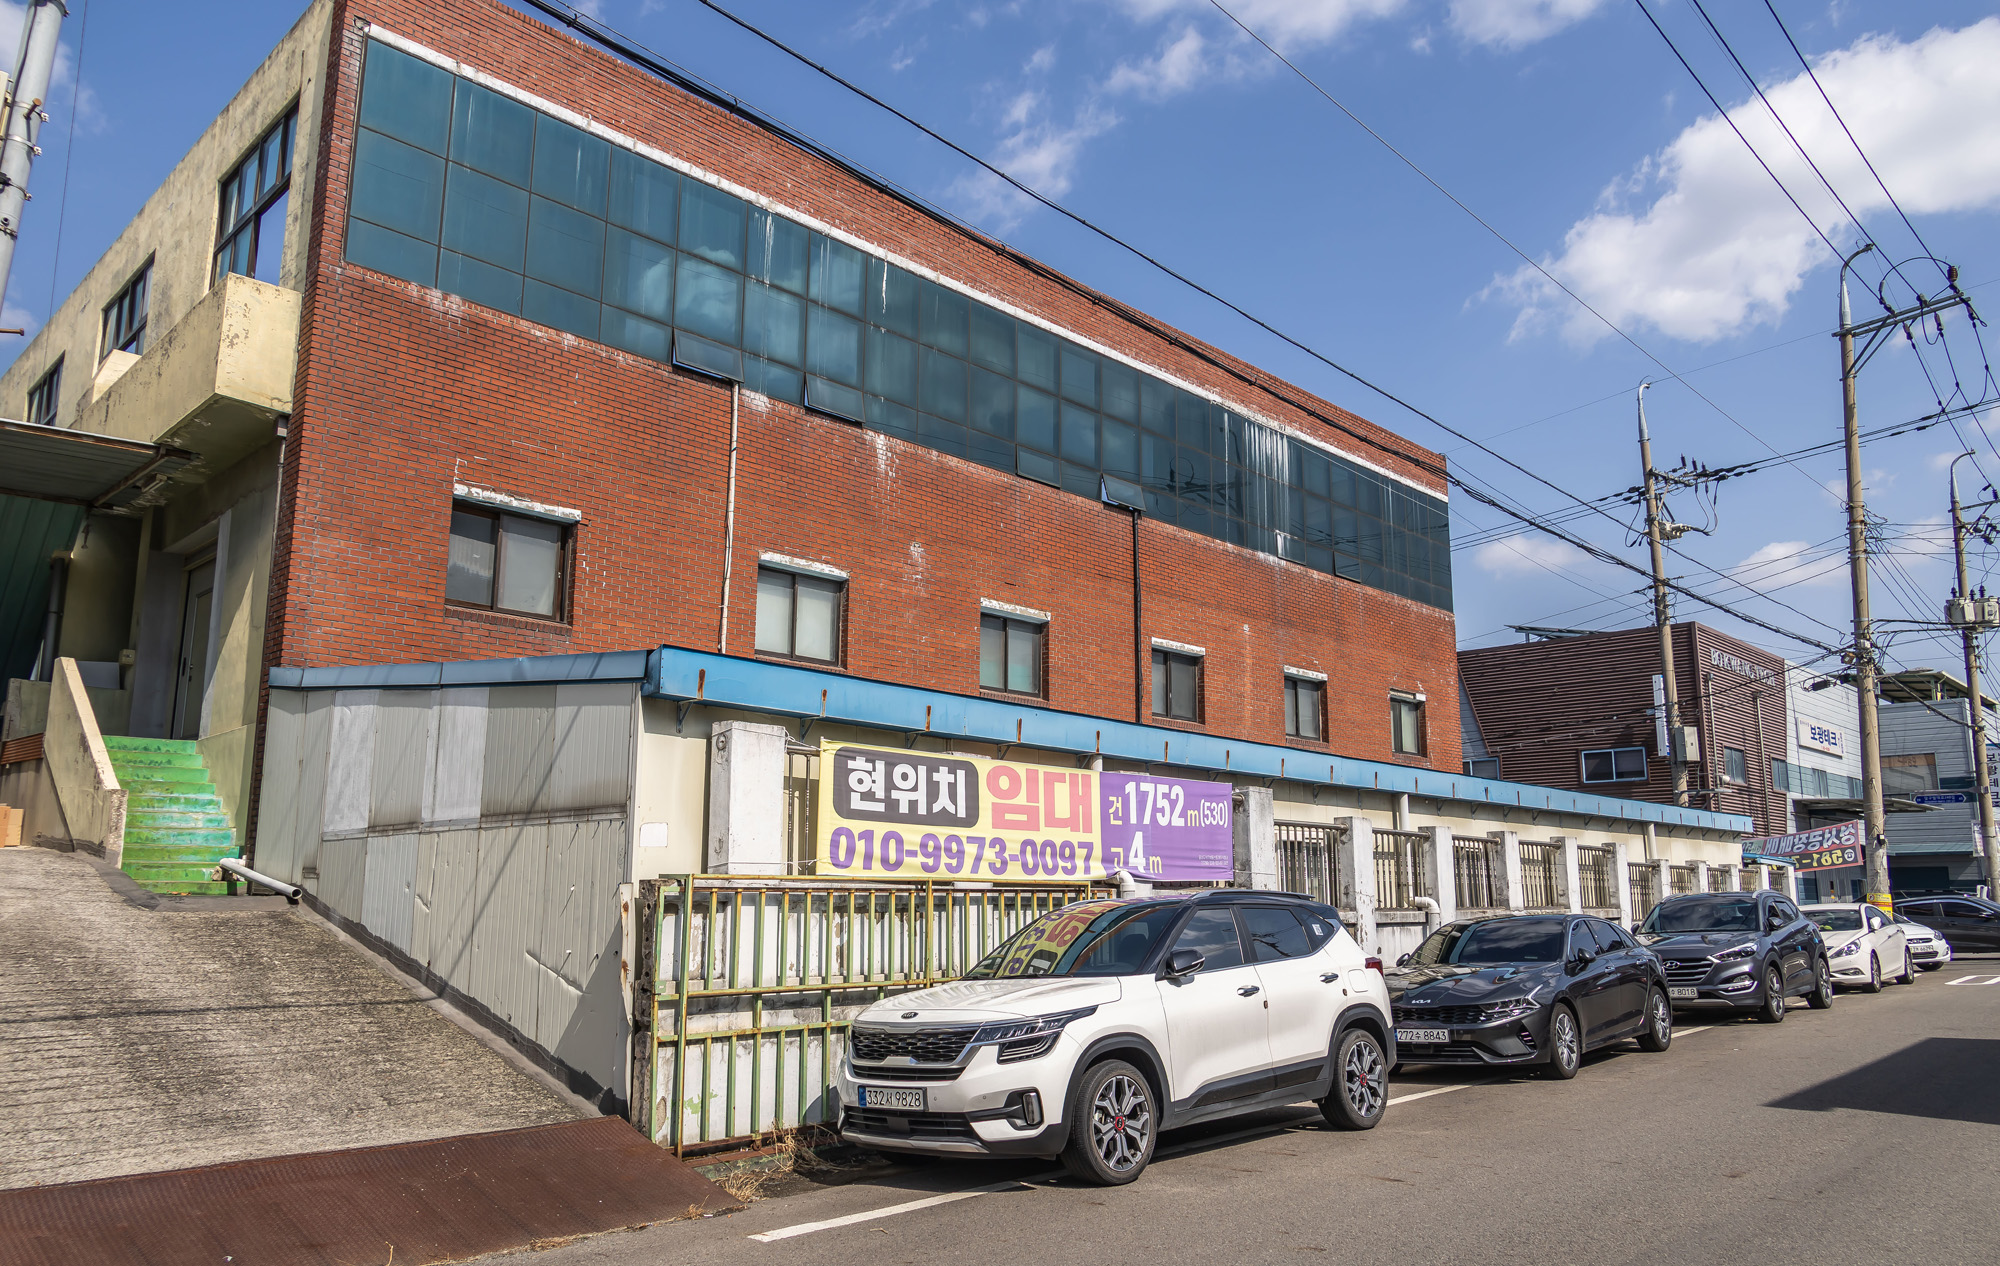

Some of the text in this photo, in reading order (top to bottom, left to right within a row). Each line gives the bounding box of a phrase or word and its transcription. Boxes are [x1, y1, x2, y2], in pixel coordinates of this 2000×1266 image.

[1810, 724, 1837, 746] 보광테크
[847, 756, 1093, 834] 현위치 임대
[829, 826, 1094, 876] 010-9973-0097
[1677, 988, 1696, 996] 8018
[1398, 1030, 1447, 1041] 272수 8843
[867, 1090, 921, 1107] 332서 9828
